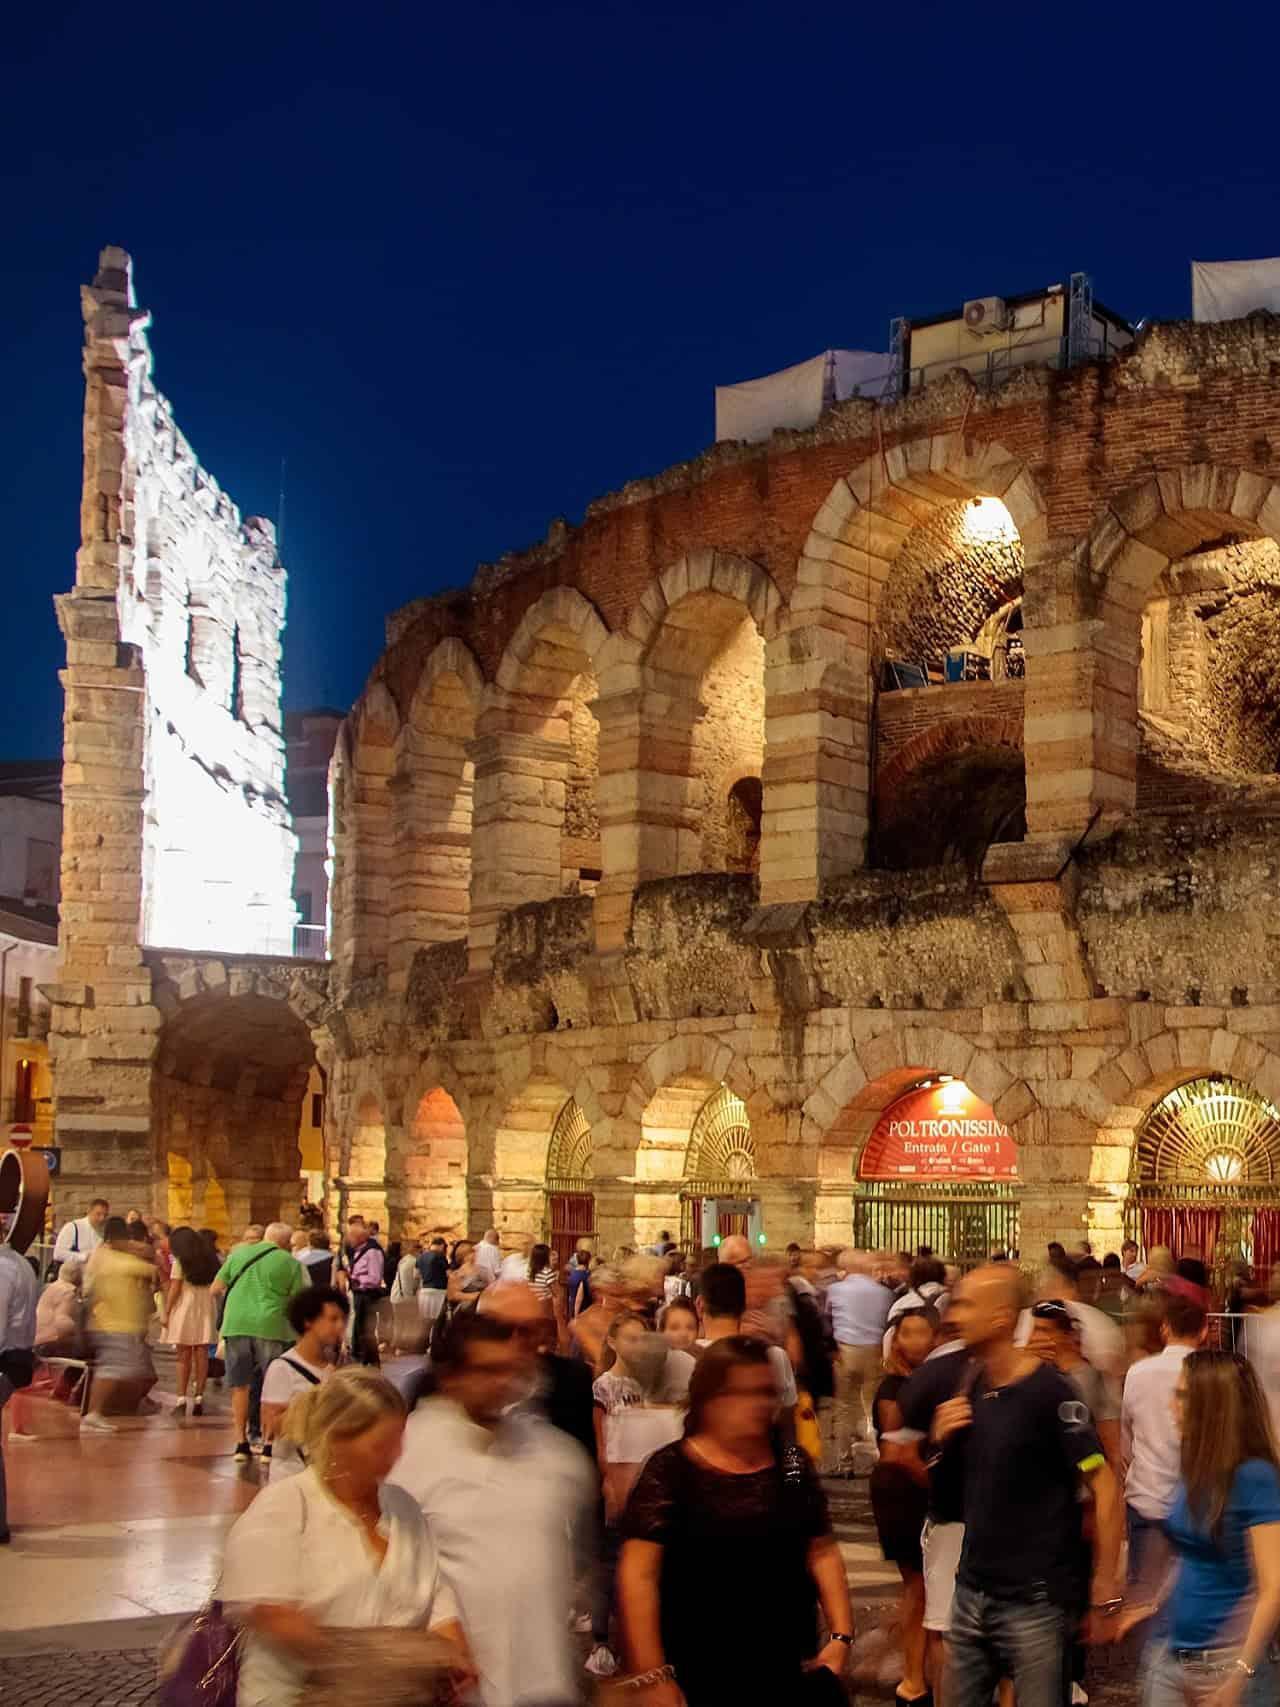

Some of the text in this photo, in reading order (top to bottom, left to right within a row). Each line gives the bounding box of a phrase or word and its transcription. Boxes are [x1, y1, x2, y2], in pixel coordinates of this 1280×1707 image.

[904, 1142, 947, 1154] Entrata
[961, 1142, 991, 1154] Gate
[994, 1142, 1000, 1153] 1
